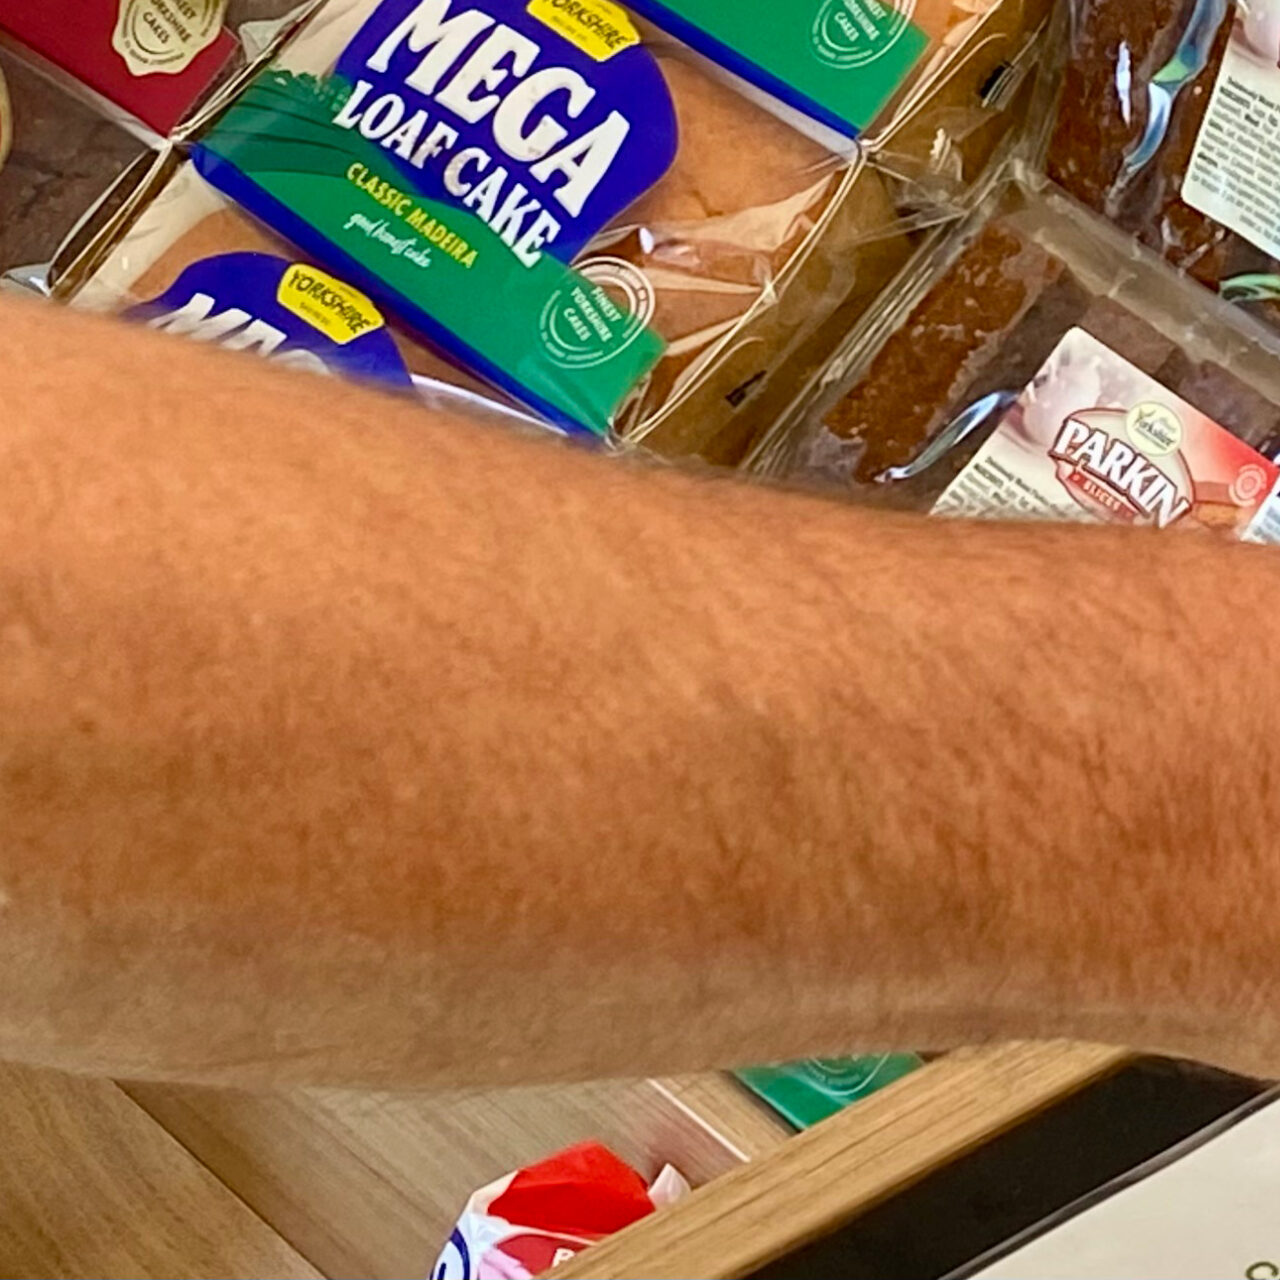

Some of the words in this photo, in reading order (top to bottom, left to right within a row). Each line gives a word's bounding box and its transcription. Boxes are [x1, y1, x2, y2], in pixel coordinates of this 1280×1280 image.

[143, 11, 170, 44] CAKES
[332, 80, 459, 170] LOAF
[443, 147, 561, 269] CAKE
[346, 162, 412, 217] CLASSIC
[404, 207, 479, 269] MADEIRA
[1049, 418, 1192, 530] PARKIN
